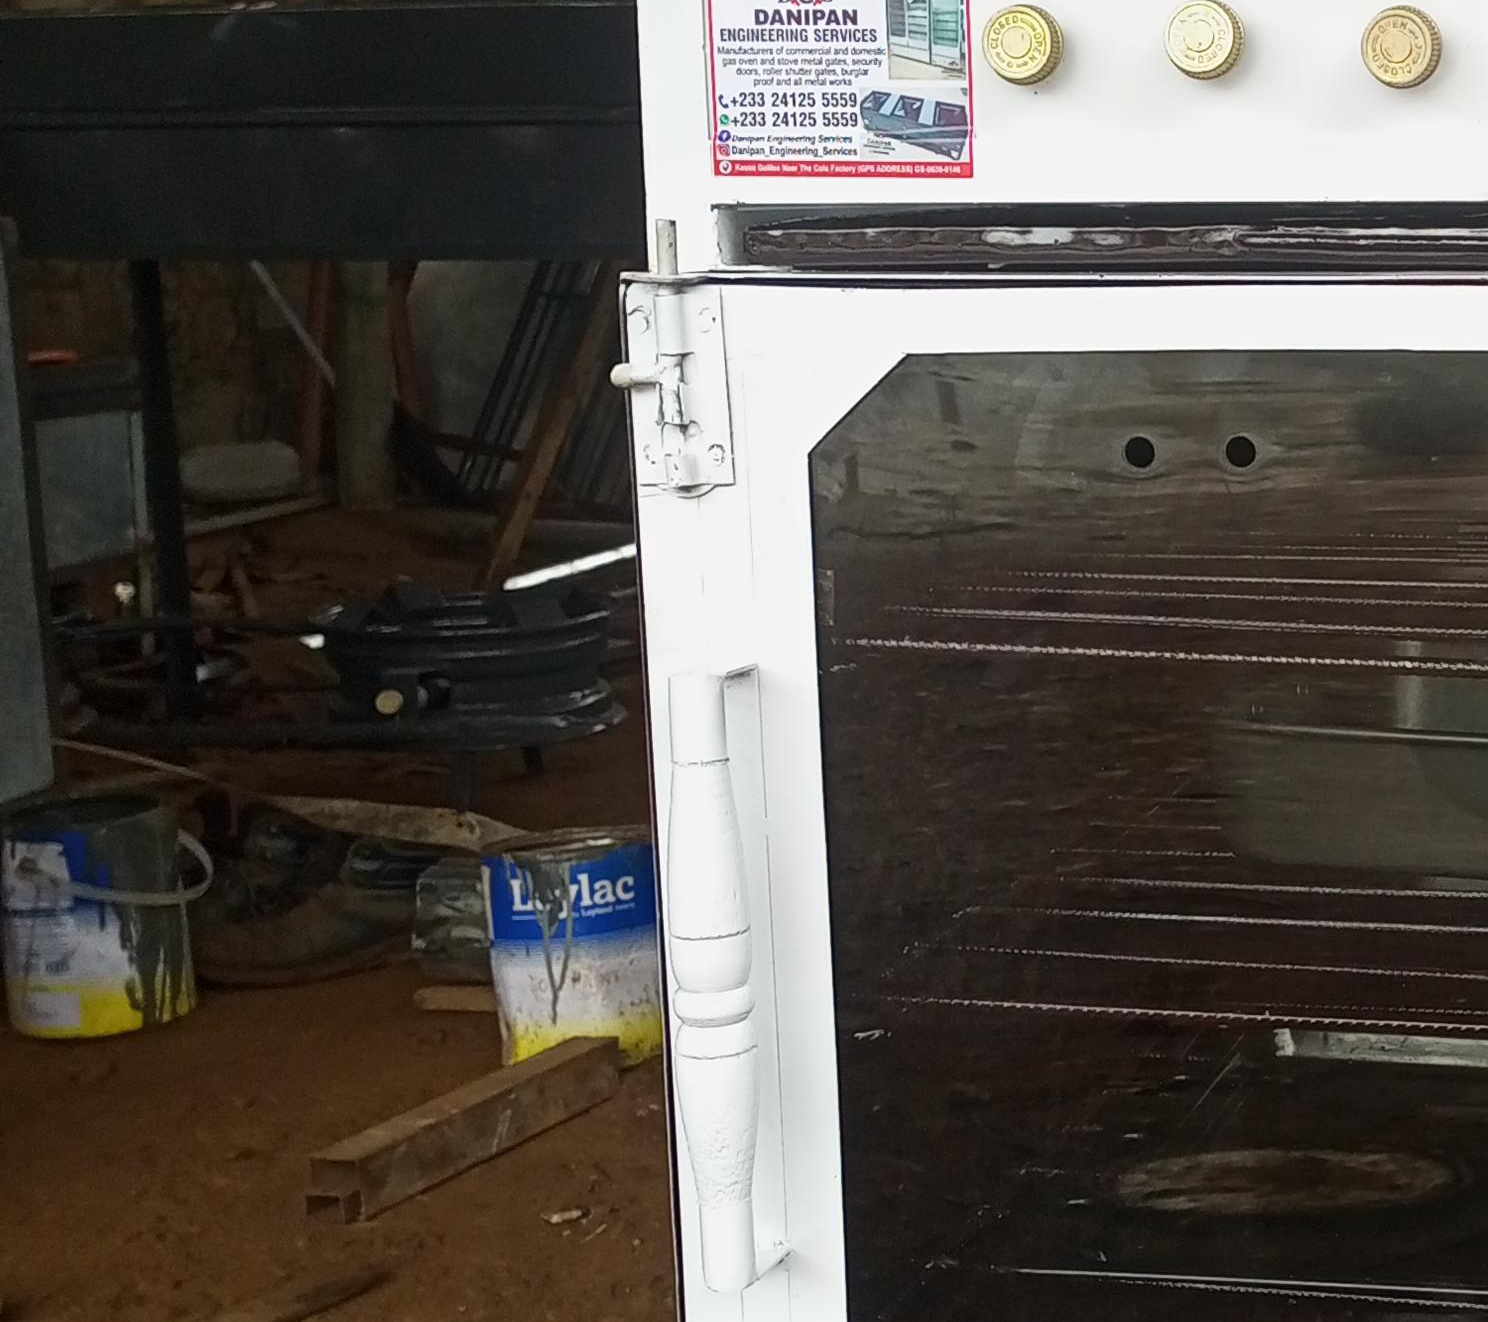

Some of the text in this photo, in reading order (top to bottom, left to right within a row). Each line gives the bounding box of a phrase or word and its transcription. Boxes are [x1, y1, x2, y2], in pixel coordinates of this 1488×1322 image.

[754, 9, 858, 26] DANIPAN
[720, 28, 877, 43] ENGINEERING SERVICES
[989, 15, 1019, 50] CLOSED
[717, 46, 886, 56] Manufacturers of commercial and domestic
[1028, 32, 1042, 64] OPEN
[722, 59, 736, 67] gas
[738, 58, 758, 66] oven
[760, 57, 775, 66] and
[777, 57, 799, 66] stove
[801, 57, 823, 66] metal
[851, 57, 883, 68] security
[763, 68, 782, 76] roller
[785, 68, 812, 76] shutter
[841, 68, 869, 79] burglar
[753, 78, 853, 87] proof and all metal works
[730, 92, 858, 108] +233 24125 5559
[731, 112, 858, 127] +233 24125 5559
[732, 135, 853, 144] Danipan Engineering Services
